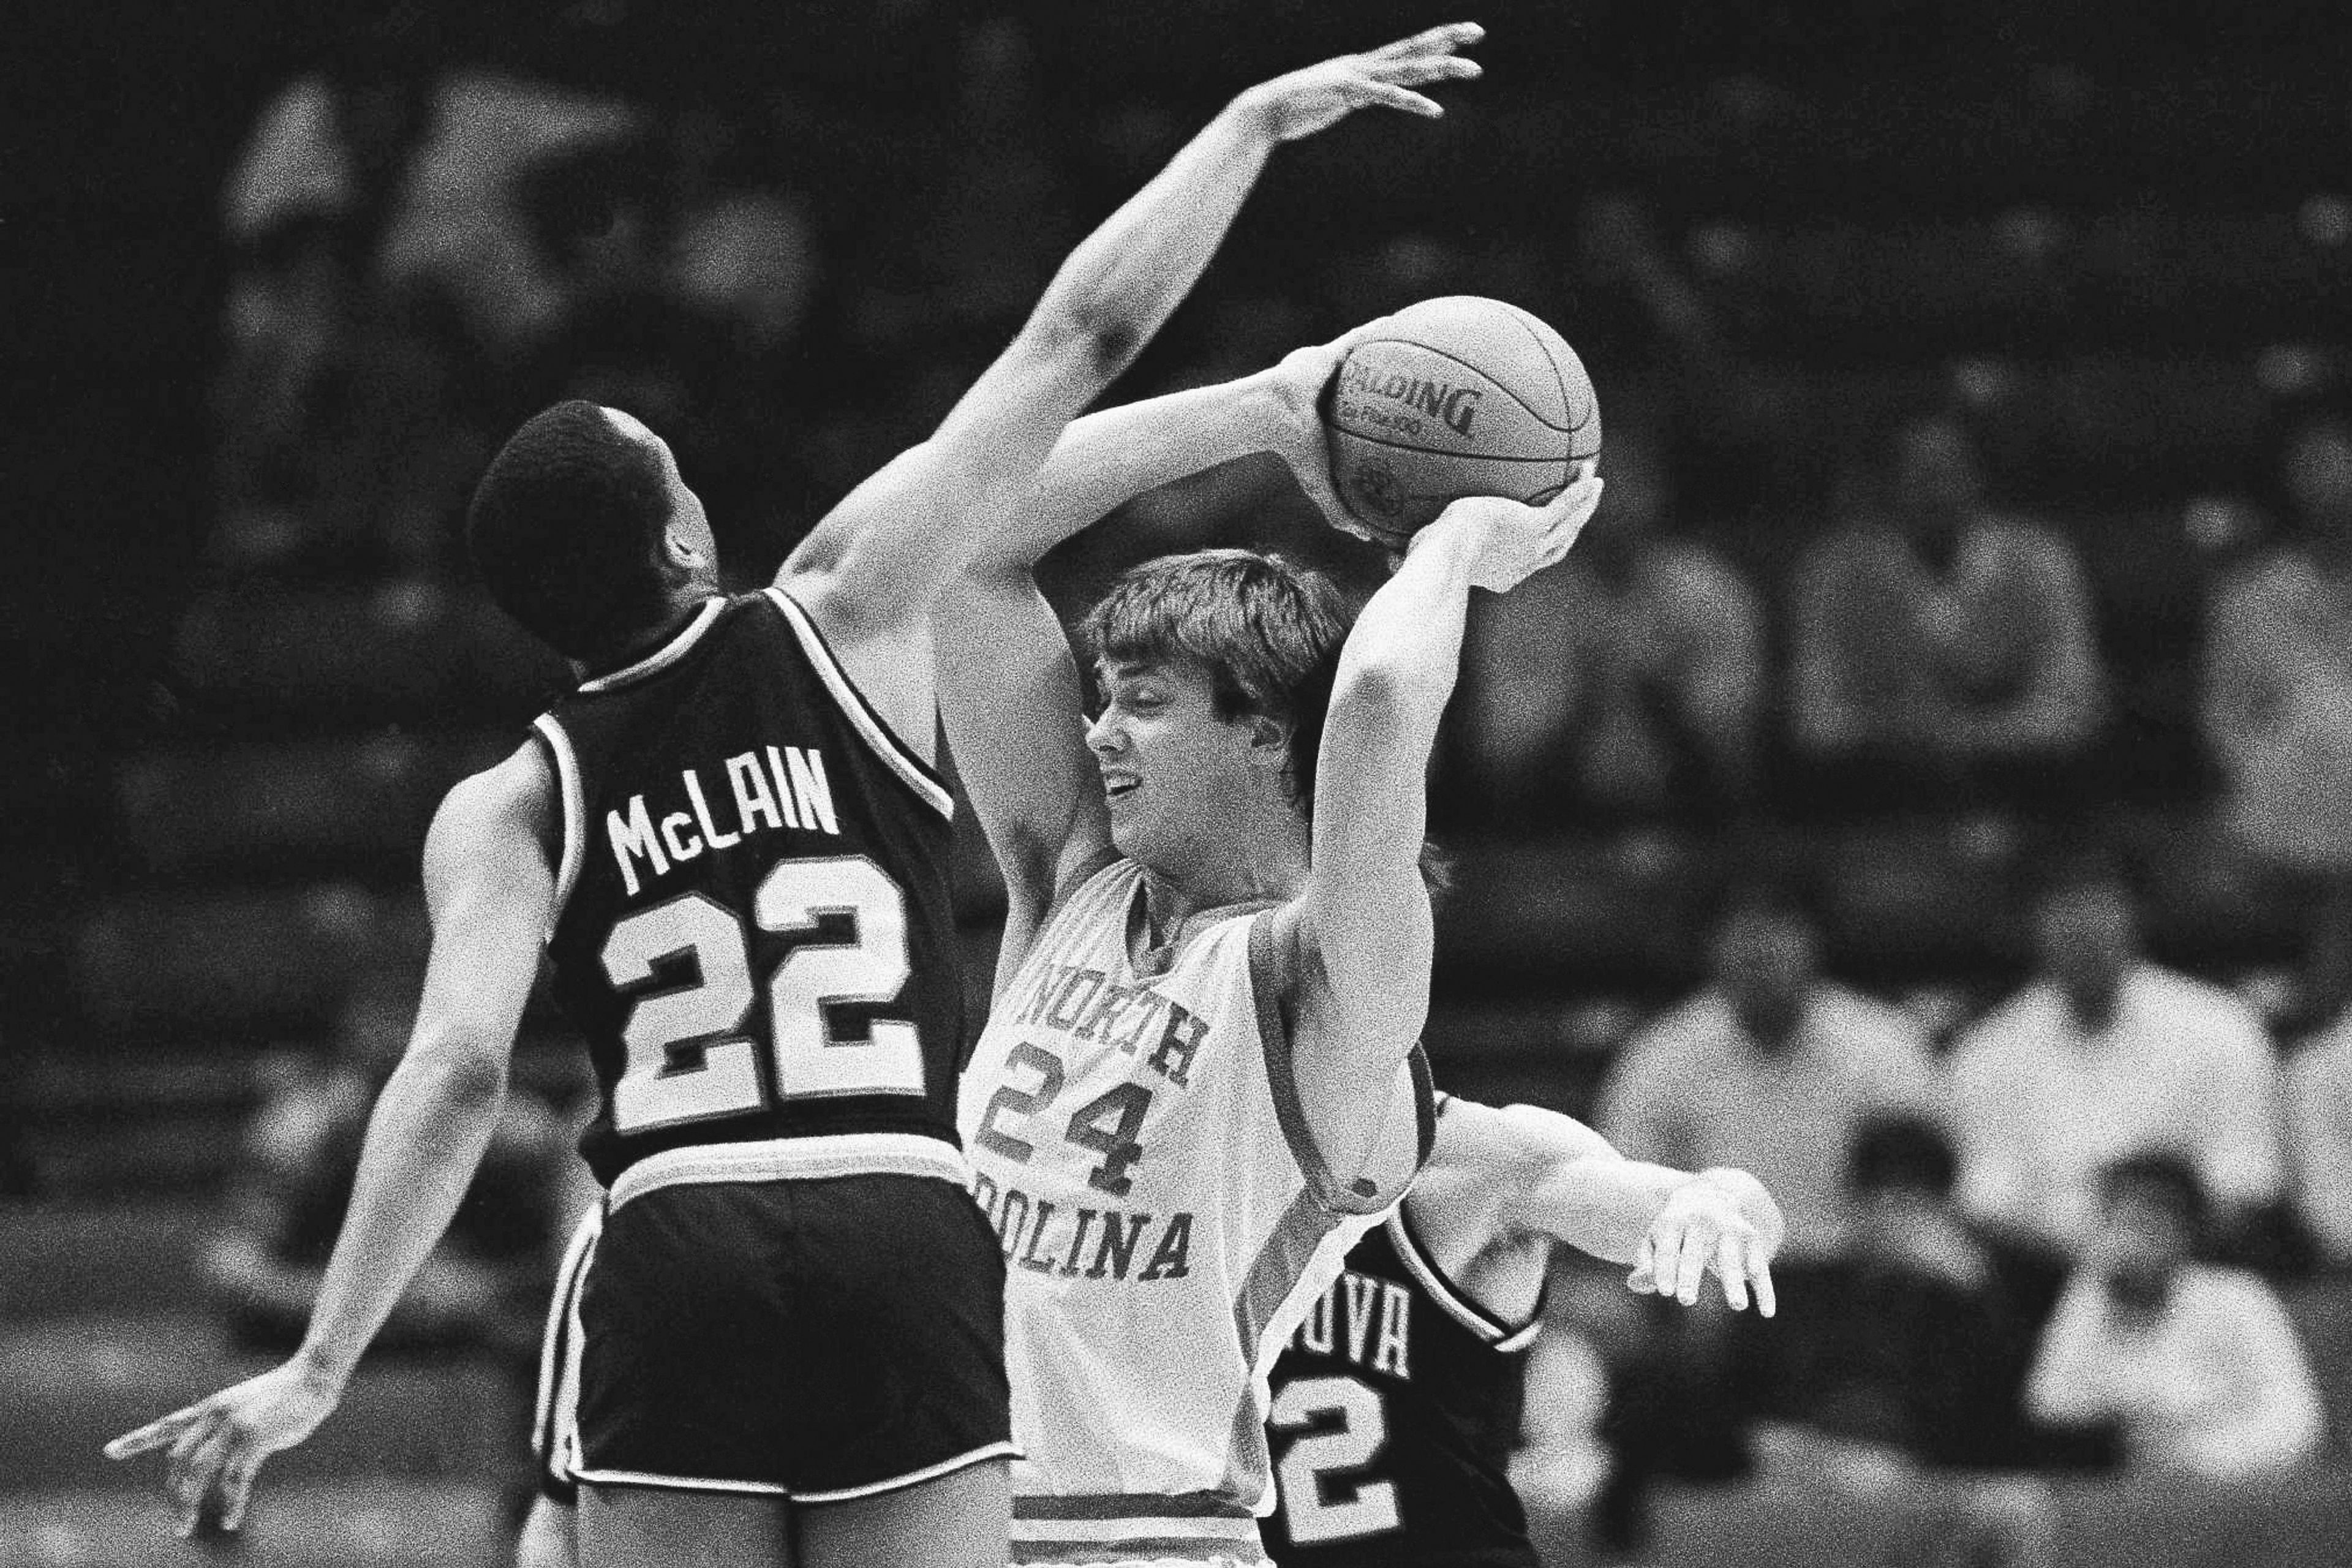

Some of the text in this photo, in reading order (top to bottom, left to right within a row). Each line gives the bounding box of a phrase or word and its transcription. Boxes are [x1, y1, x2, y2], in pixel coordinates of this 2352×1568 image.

[607, 745, 839, 896] McLAIN
[600, 853, 926, 1135] 22
[1012, 964, 1211, 1090] NORTH
[973, 1041, 1153, 1197] 24
[1285, 1270, 1410, 1380] OVA
